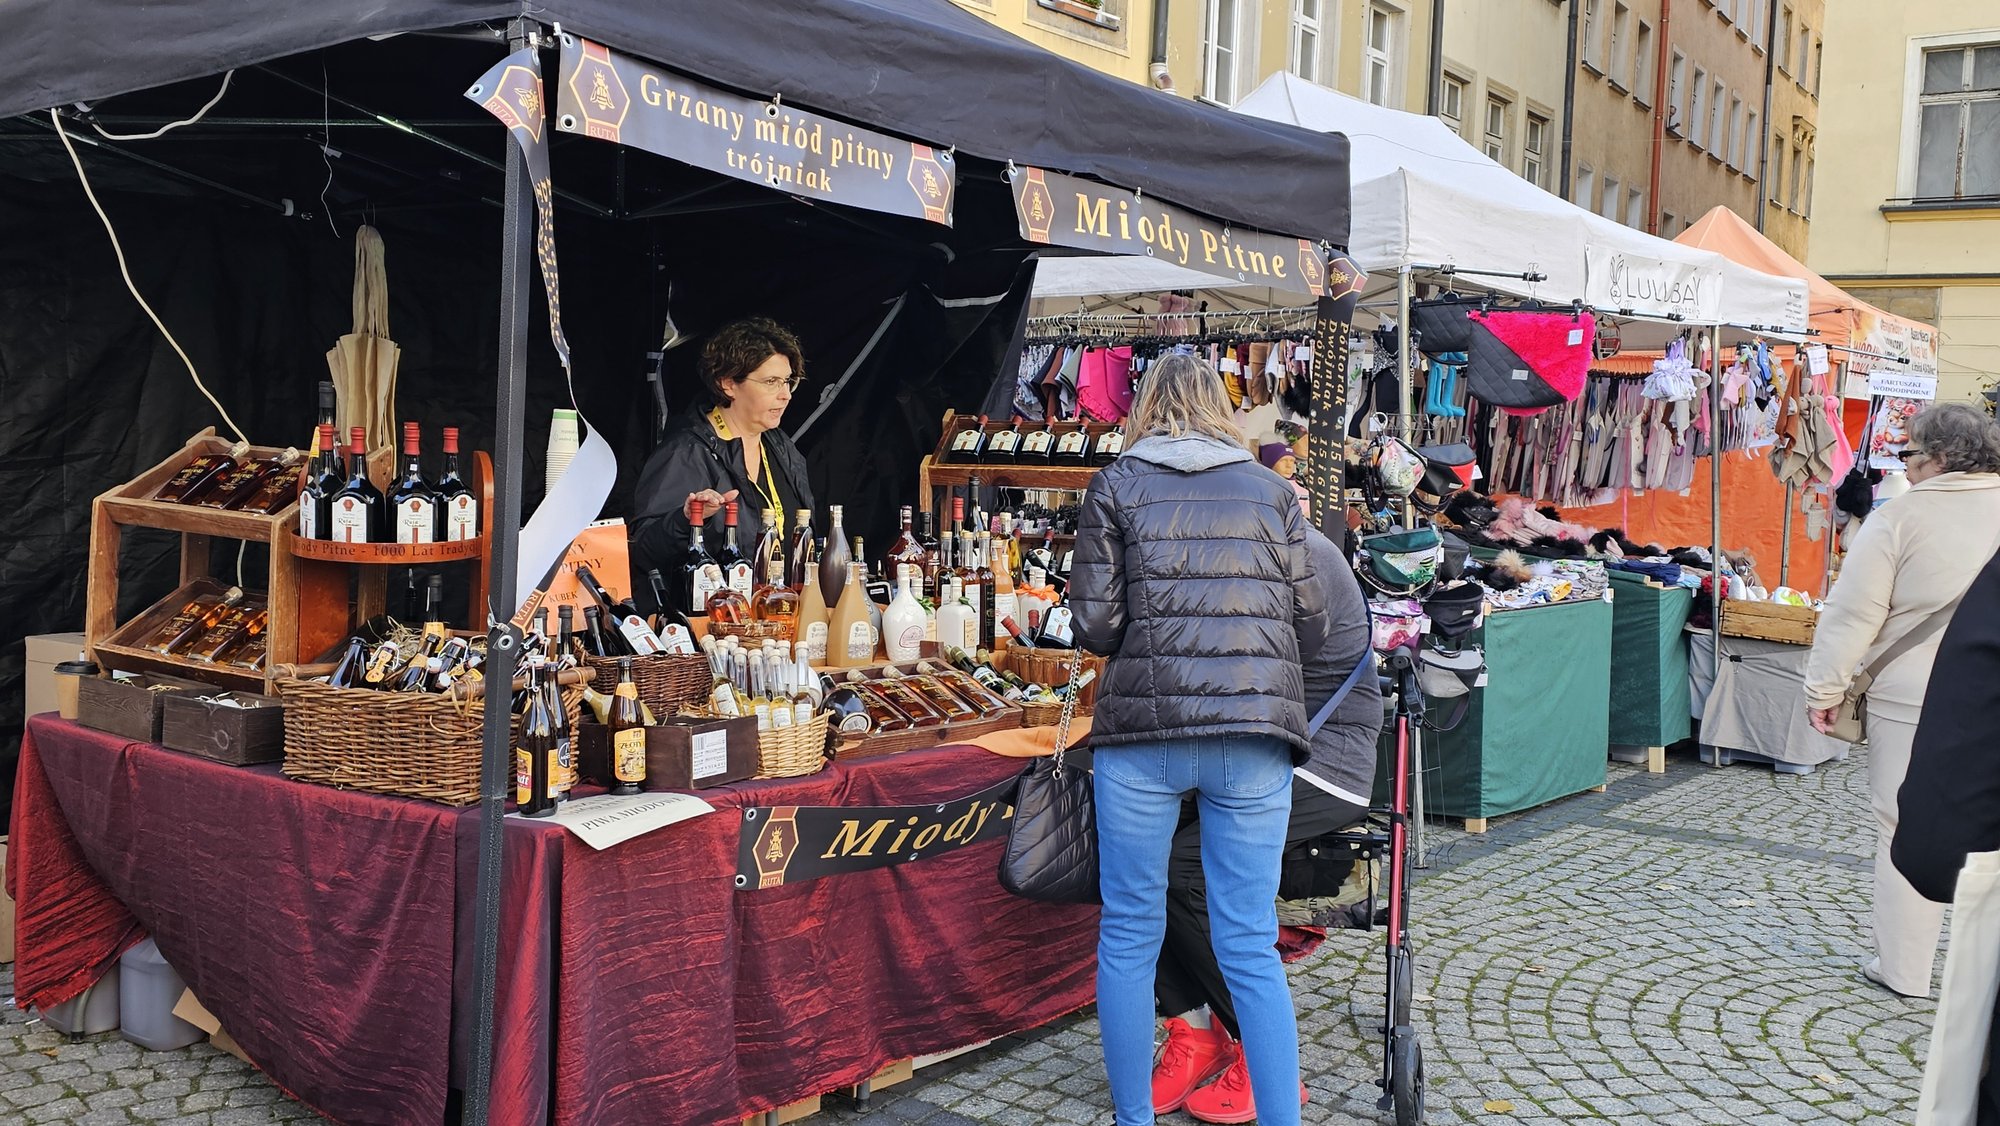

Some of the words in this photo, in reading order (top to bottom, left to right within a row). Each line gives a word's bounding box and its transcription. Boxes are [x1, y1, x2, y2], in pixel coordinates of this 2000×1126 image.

[488, 101, 514, 126] RUTA
[590, 126, 617, 141] RUTA
[640, 73, 744, 142] Grzany
[754, 114, 822, 155] miód
[830, 133, 893, 180] pitny
[726, 147, 833, 193] trójniak
[1074, 192, 1190, 265] Miody
[1200, 229, 1287, 278] Pitne
[1312, 319, 1327, 401] Trójniak
[1323, 319, 1338, 411] Dwójniak
[1335, 320, 1350, 406] Półtorak
[1872, 385, 1931, 396] WODOODPORNE
[1880, 379, 1922, 388] FARTUSZKI
[1309, 433, 1318, 444] 3
[1319, 436, 1328, 459] 15
[1331, 439, 1342, 462] 15
[1318, 463, 1326, 471] i
[1317, 476, 1325, 487] 6
[1329, 467, 1342, 511] letni
[322, 543, 356, 556] Pitne
[374, 545, 406, 557] 1000
[412, 545, 433, 556] Lat
[514, 593, 539, 621] RUTA
[549, 591, 578, 603] KUBEK
[581, 815, 621, 830] PIWA
[820, 800, 997, 860] Miody
[762, 876, 781, 887] RUTA
